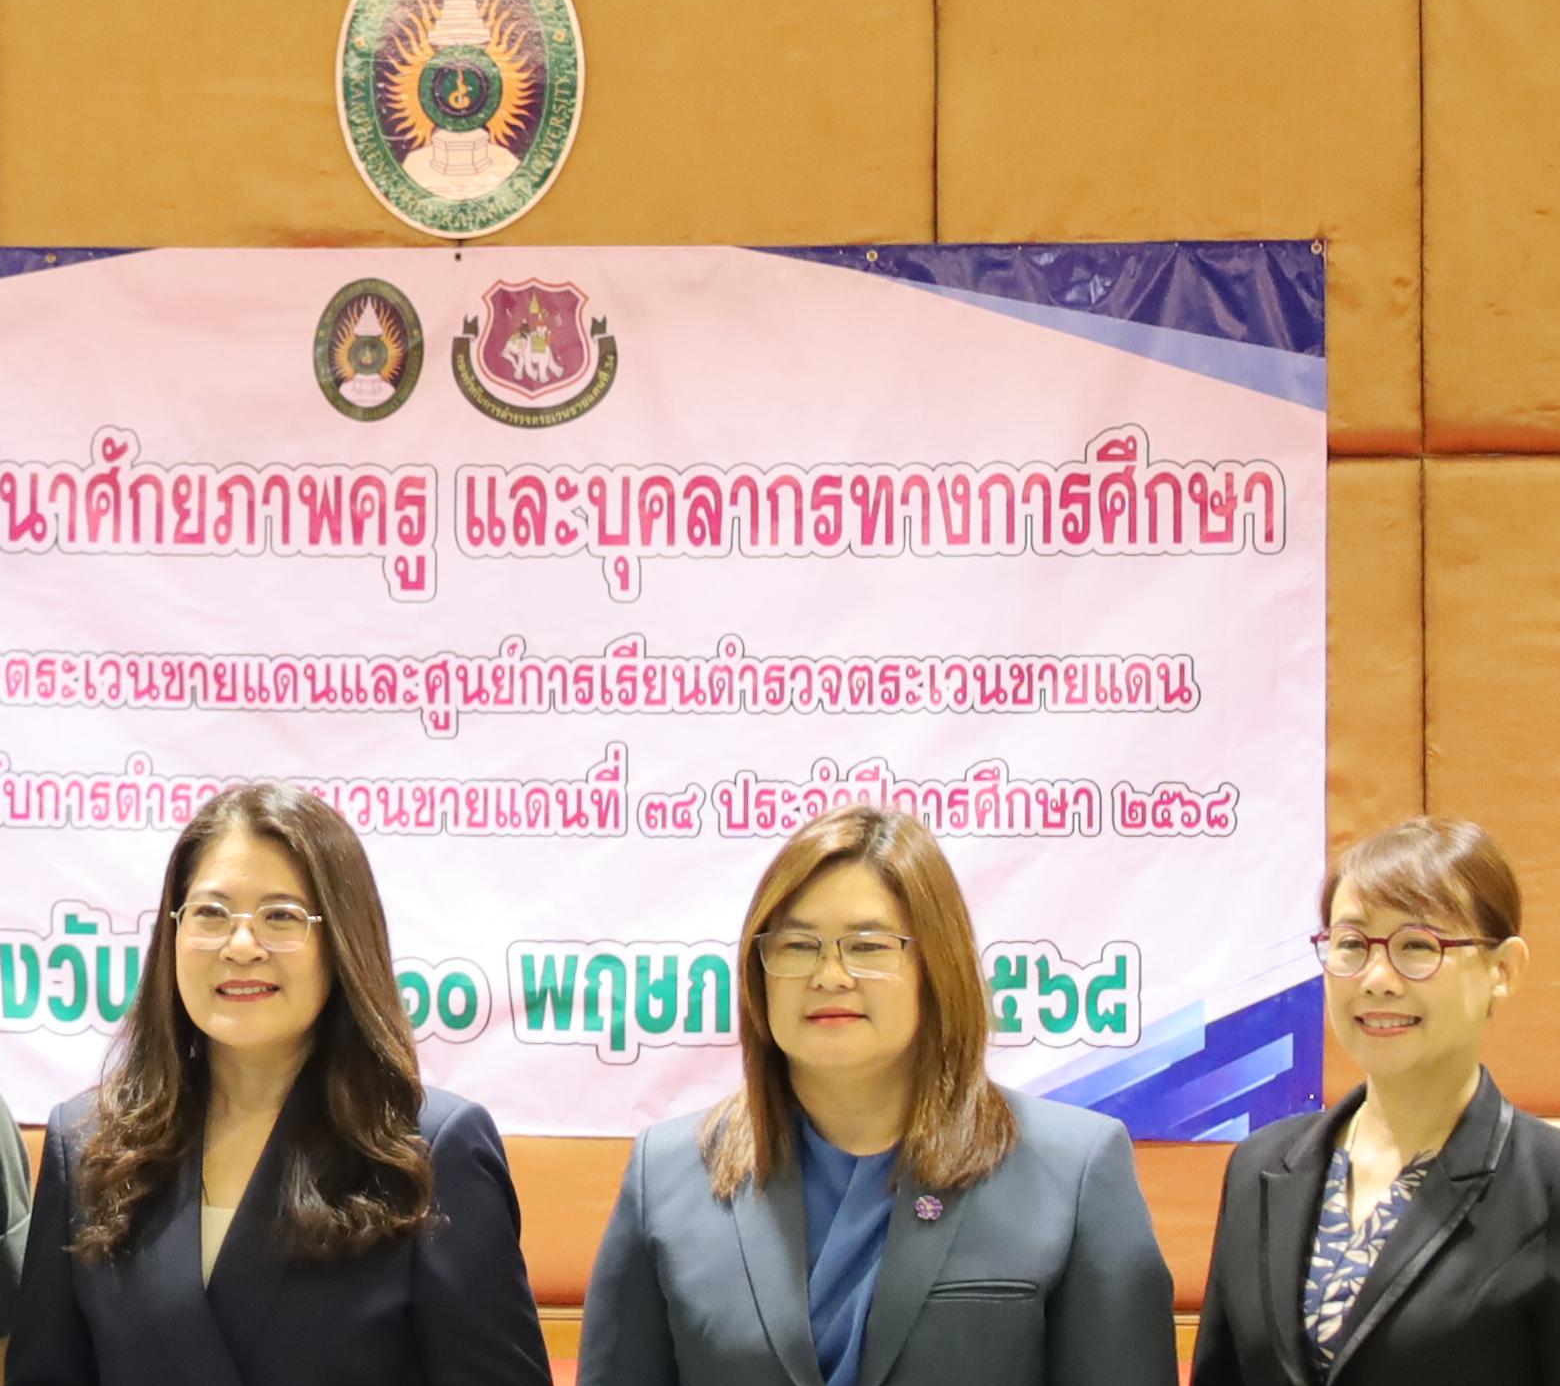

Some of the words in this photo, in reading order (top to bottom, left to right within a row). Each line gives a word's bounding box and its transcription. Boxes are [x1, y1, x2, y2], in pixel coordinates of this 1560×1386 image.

[465, 435, 1276, 592] และบุคลากรทางการศึกษา
[644, 795, 698, 830] ๓๔
[1119, 789, 1232, 830] ๒๕๖๘
[521, 954, 732, 1051] พฤษภ
[988, 955, 1128, 1034] ๕๖๘
